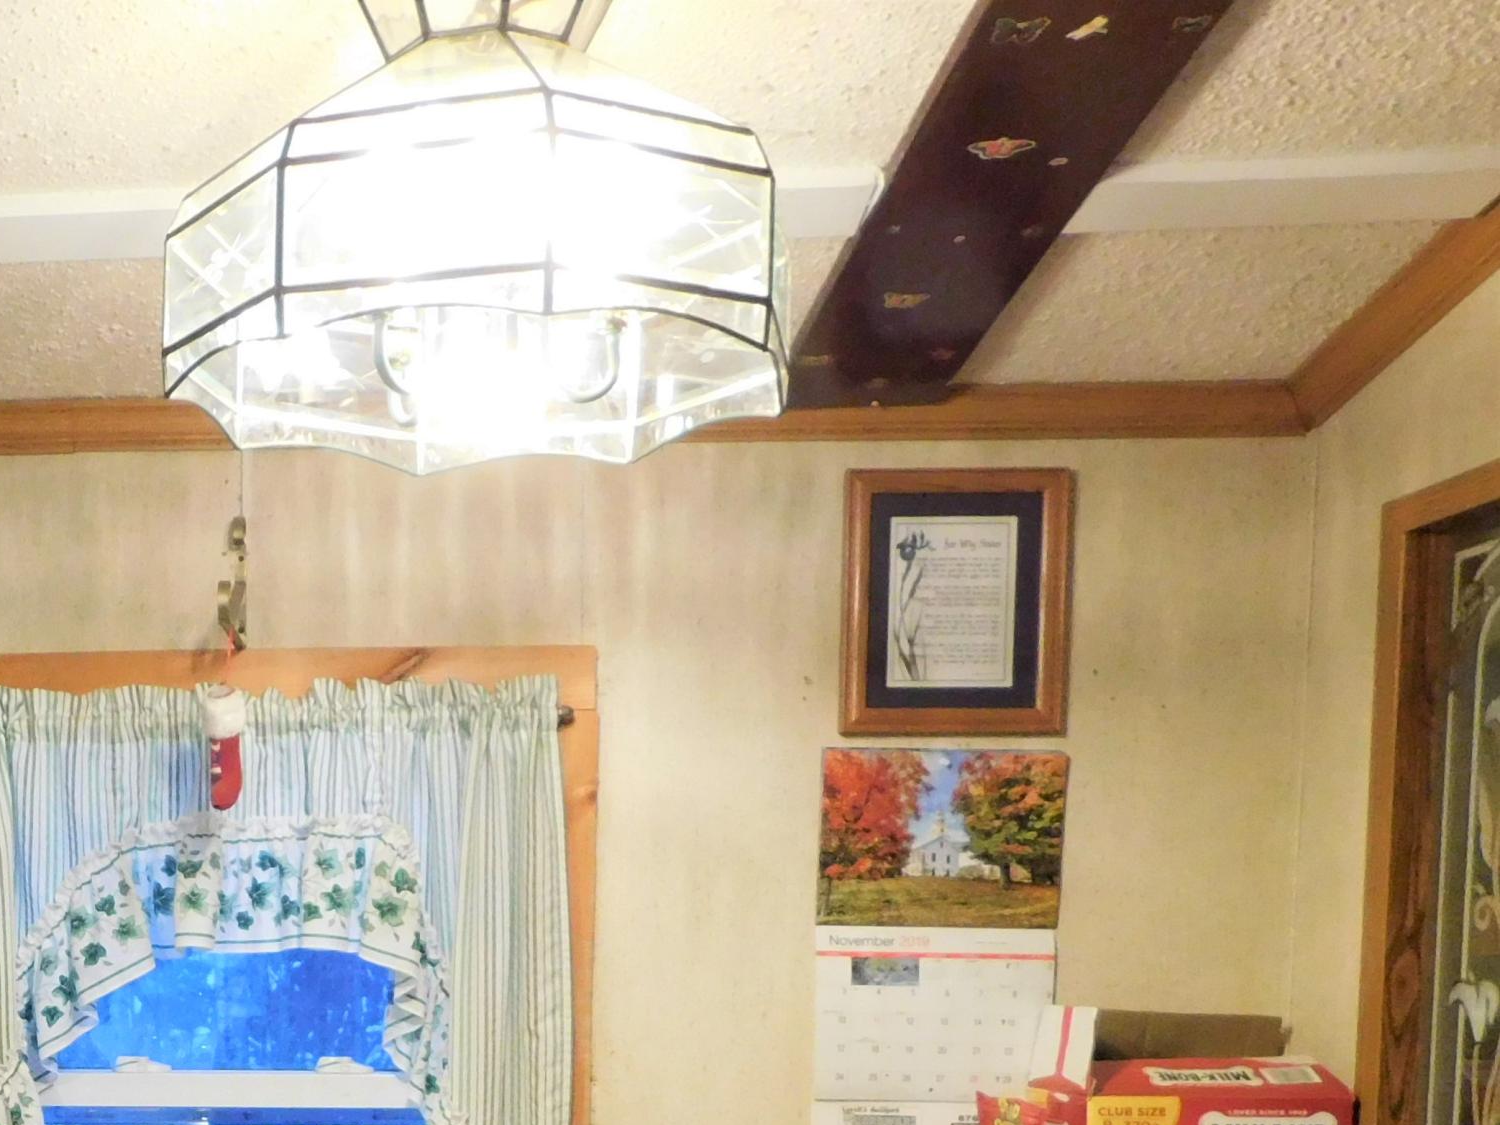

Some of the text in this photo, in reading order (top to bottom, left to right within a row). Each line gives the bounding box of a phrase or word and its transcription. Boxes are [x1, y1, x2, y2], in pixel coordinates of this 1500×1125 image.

[829, 935, 895, 947] November
[1098, 1106, 1166, 1117] CLUB SIZE
